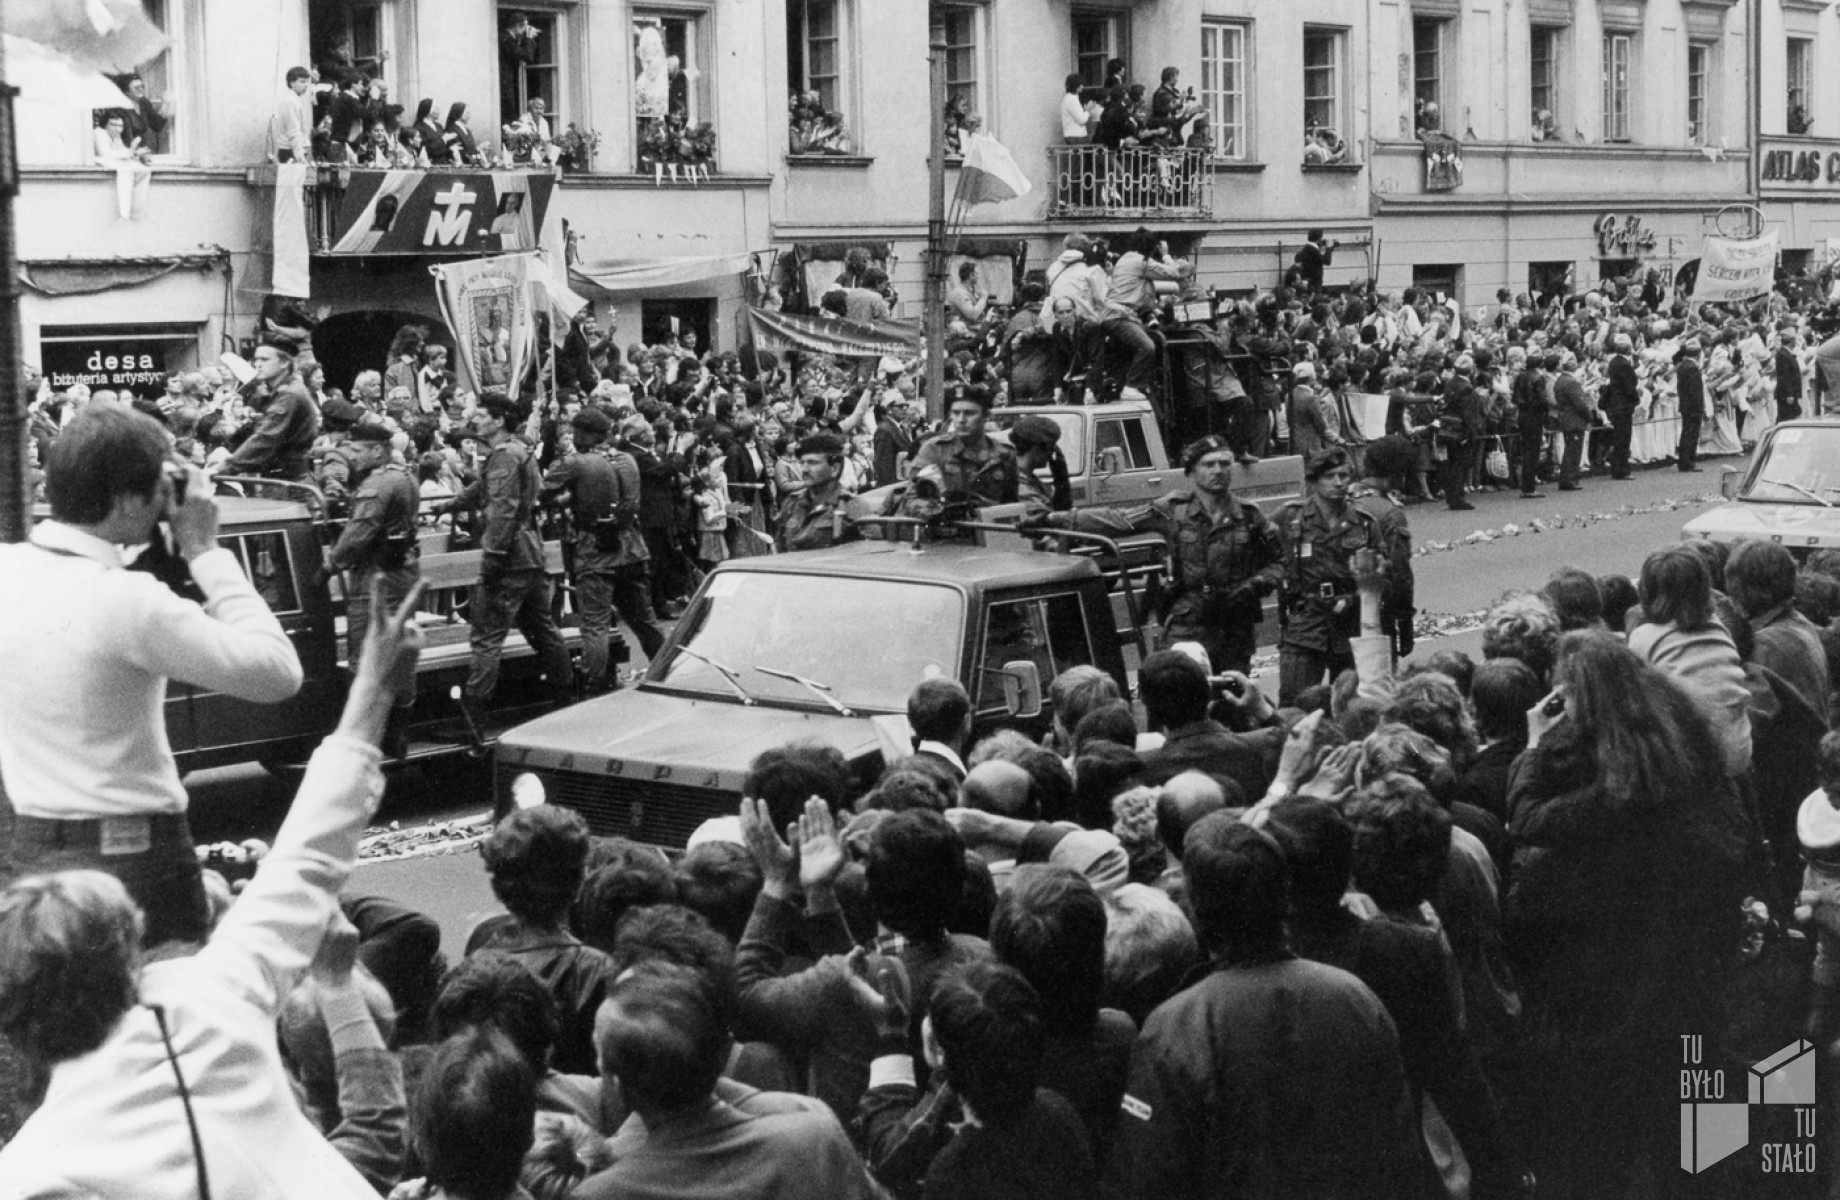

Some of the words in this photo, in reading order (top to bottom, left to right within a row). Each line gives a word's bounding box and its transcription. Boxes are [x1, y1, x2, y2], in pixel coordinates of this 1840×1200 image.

[1762, 150, 1820, 183] ATLAS
[87, 350, 154, 371] desa
[52, 372, 109, 386] biżuteria
[517, 748, 720, 788] TARPA
